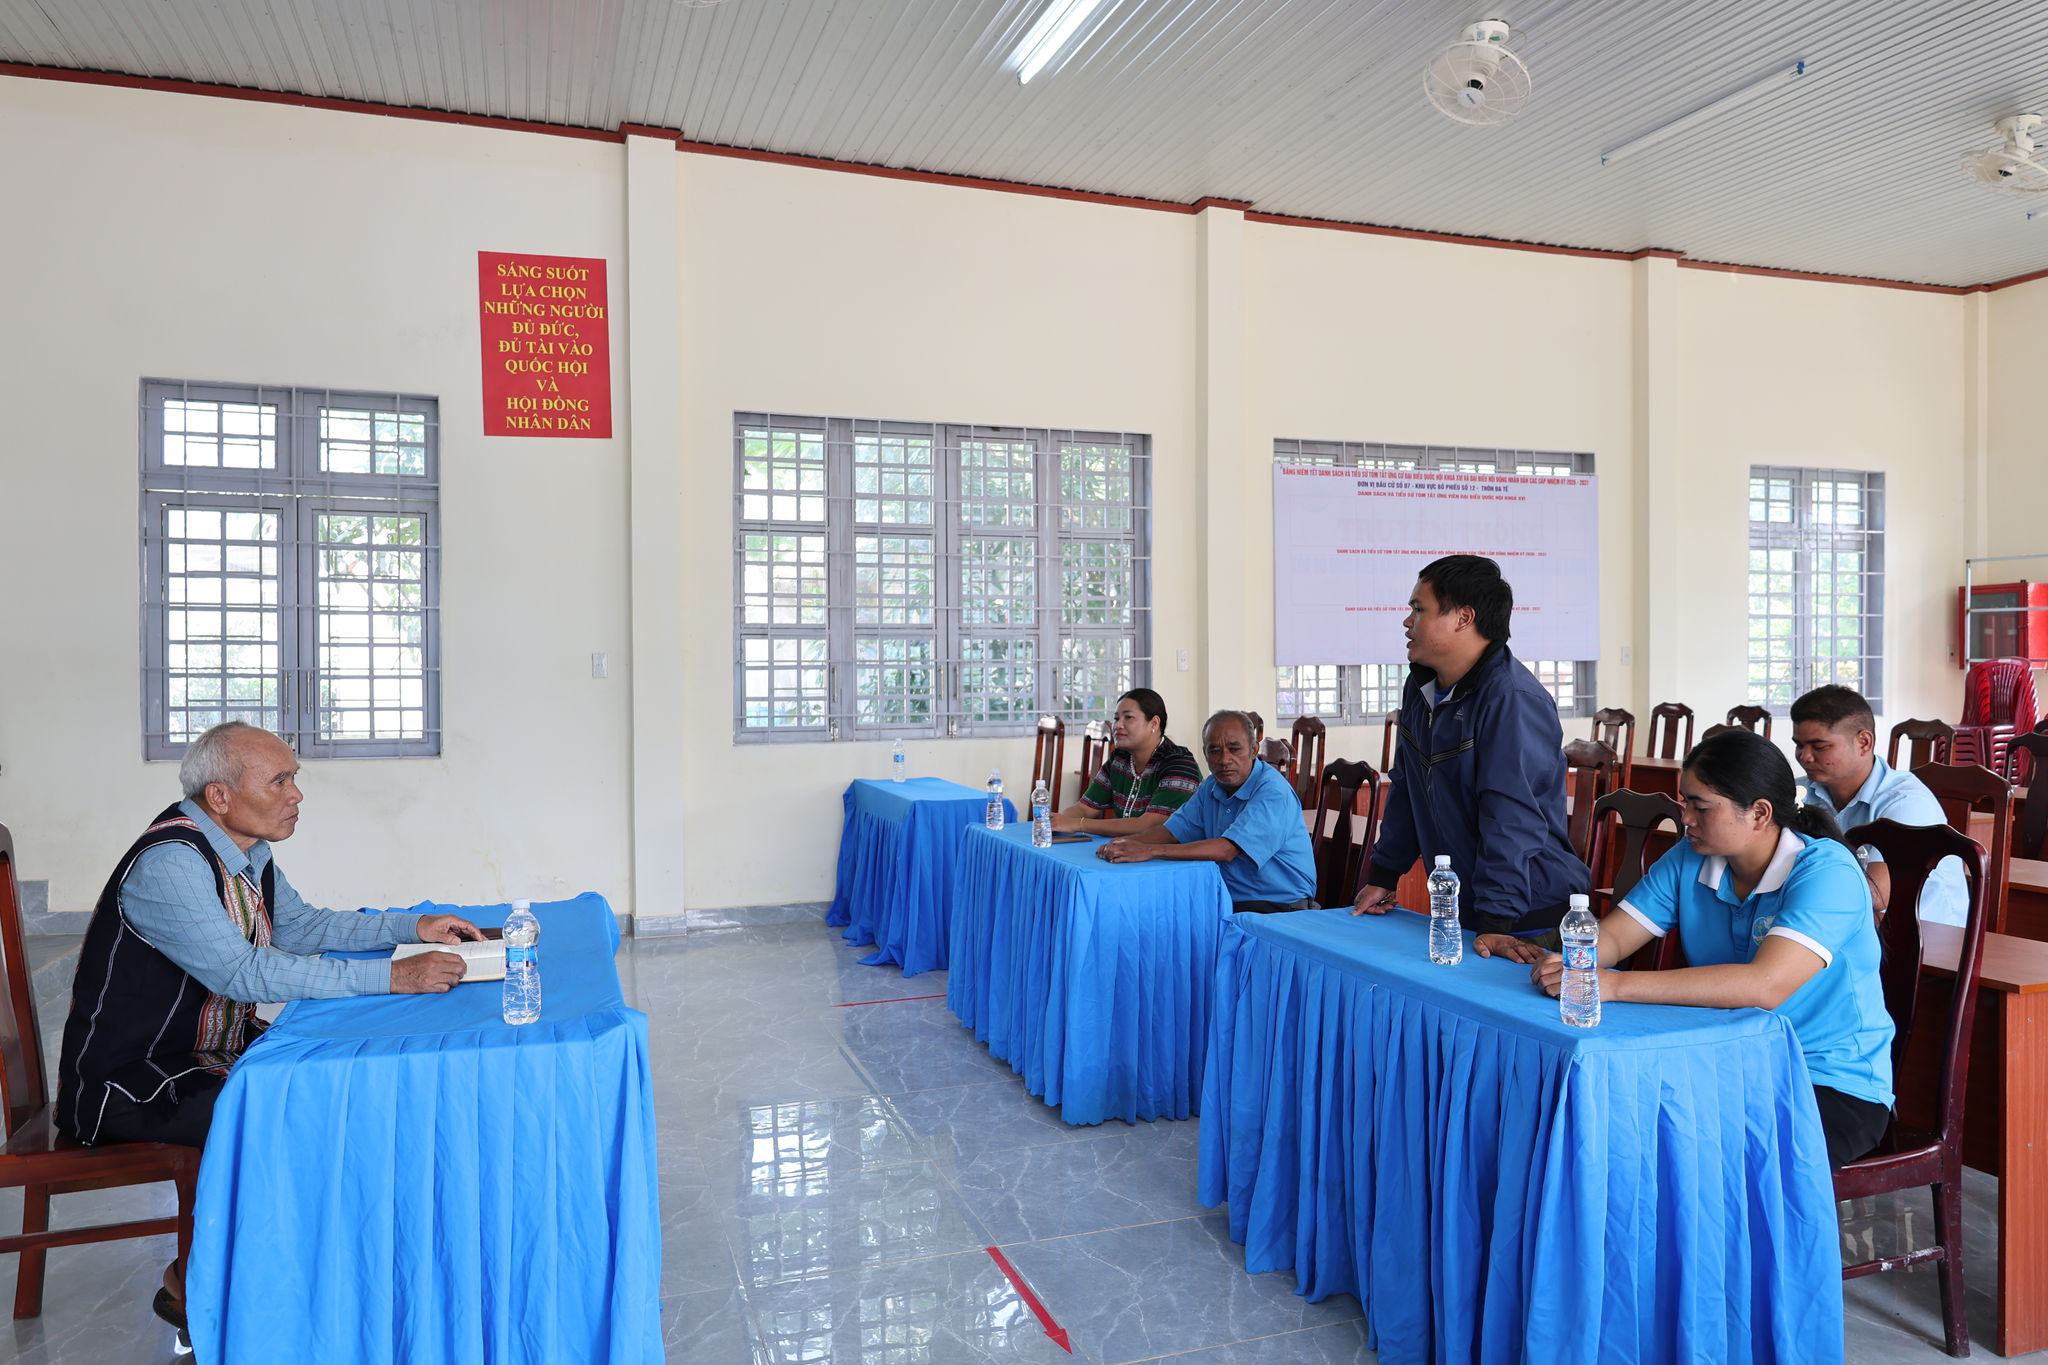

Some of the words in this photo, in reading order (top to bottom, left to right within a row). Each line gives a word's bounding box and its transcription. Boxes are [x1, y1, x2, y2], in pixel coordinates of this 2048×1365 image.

[497, 262, 542, 278] SÁNG
[502, 283, 536, 299] LỰA
[539, 286, 587, 301] CHỌN
[485, 300, 545, 316] NHỮNG
[550, 304, 604, 319] NGƯỜI
[512, 320, 534, 334] ĐỦ
[540, 320, 579, 338] ĐỨC,
[499, 338, 520, 352] ĐỦ
[526, 339, 554, 354] TÀI
[558, 340, 593, 356] VÀO
[505, 357, 552, 374] QUỐC
[558, 360, 587, 376] HỘI
[536, 376, 559, 392] VÀ
[507, 396, 537, 411] HỘI
[506, 414, 552, 429] NHÂN
[558, 415, 590, 430] DÂN
